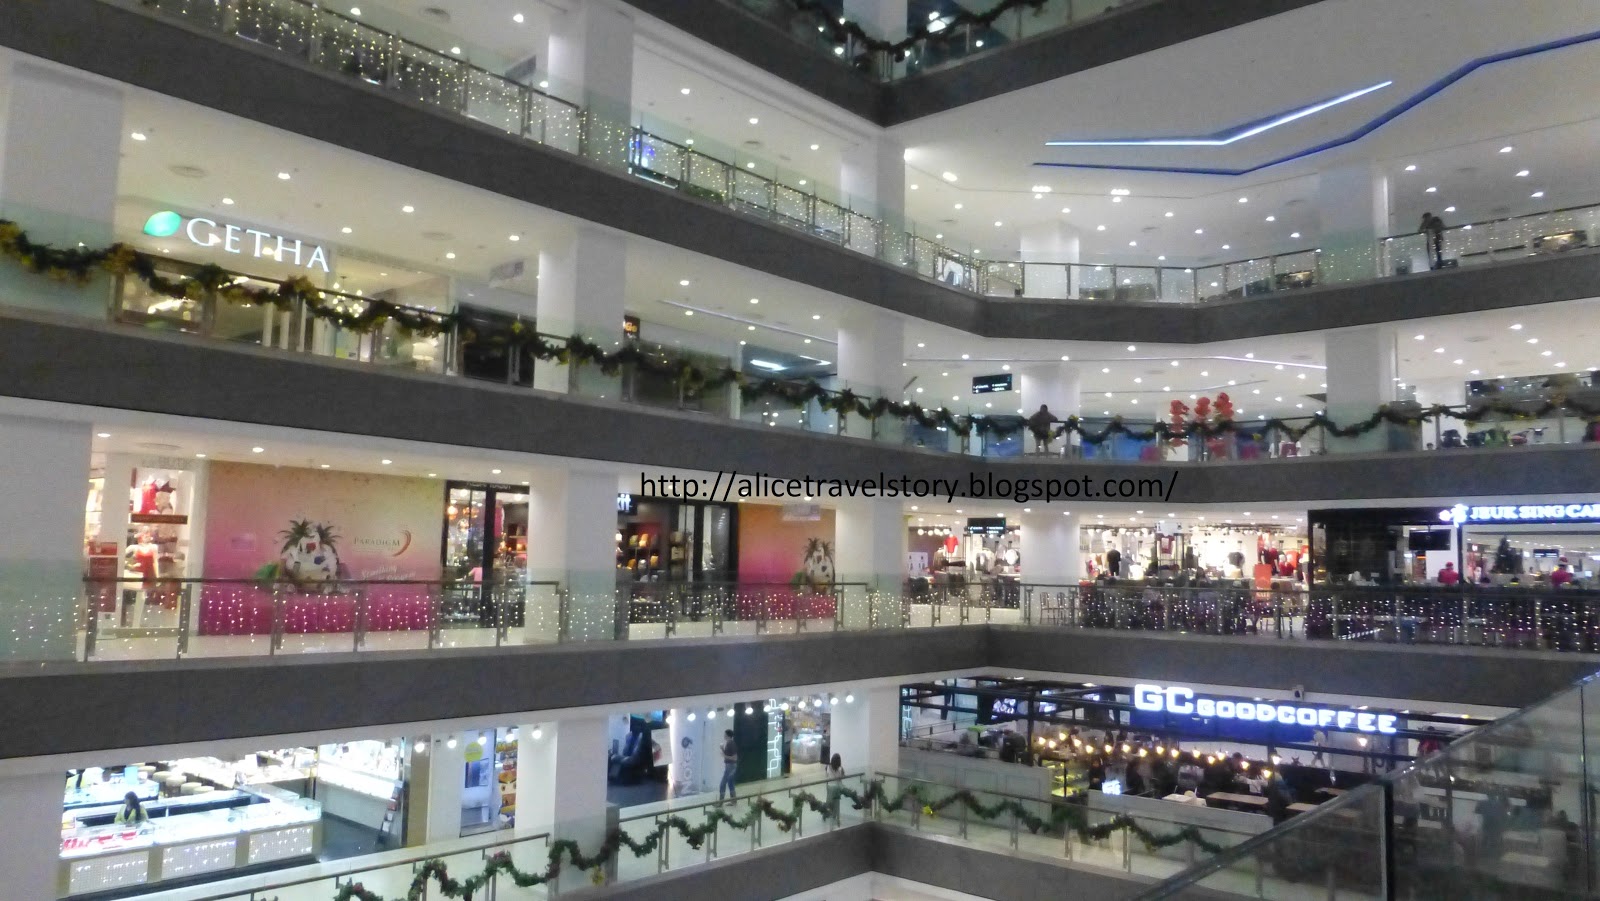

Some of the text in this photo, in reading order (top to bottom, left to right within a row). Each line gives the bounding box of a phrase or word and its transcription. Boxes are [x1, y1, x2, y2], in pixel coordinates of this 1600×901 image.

[186, 217, 330, 273] GETHA
[1518, 505, 1565, 519] SING
[353, 537, 400, 547] PARADIGM
[1134, 683, 1398, 734] GC GOODCOFFEE
